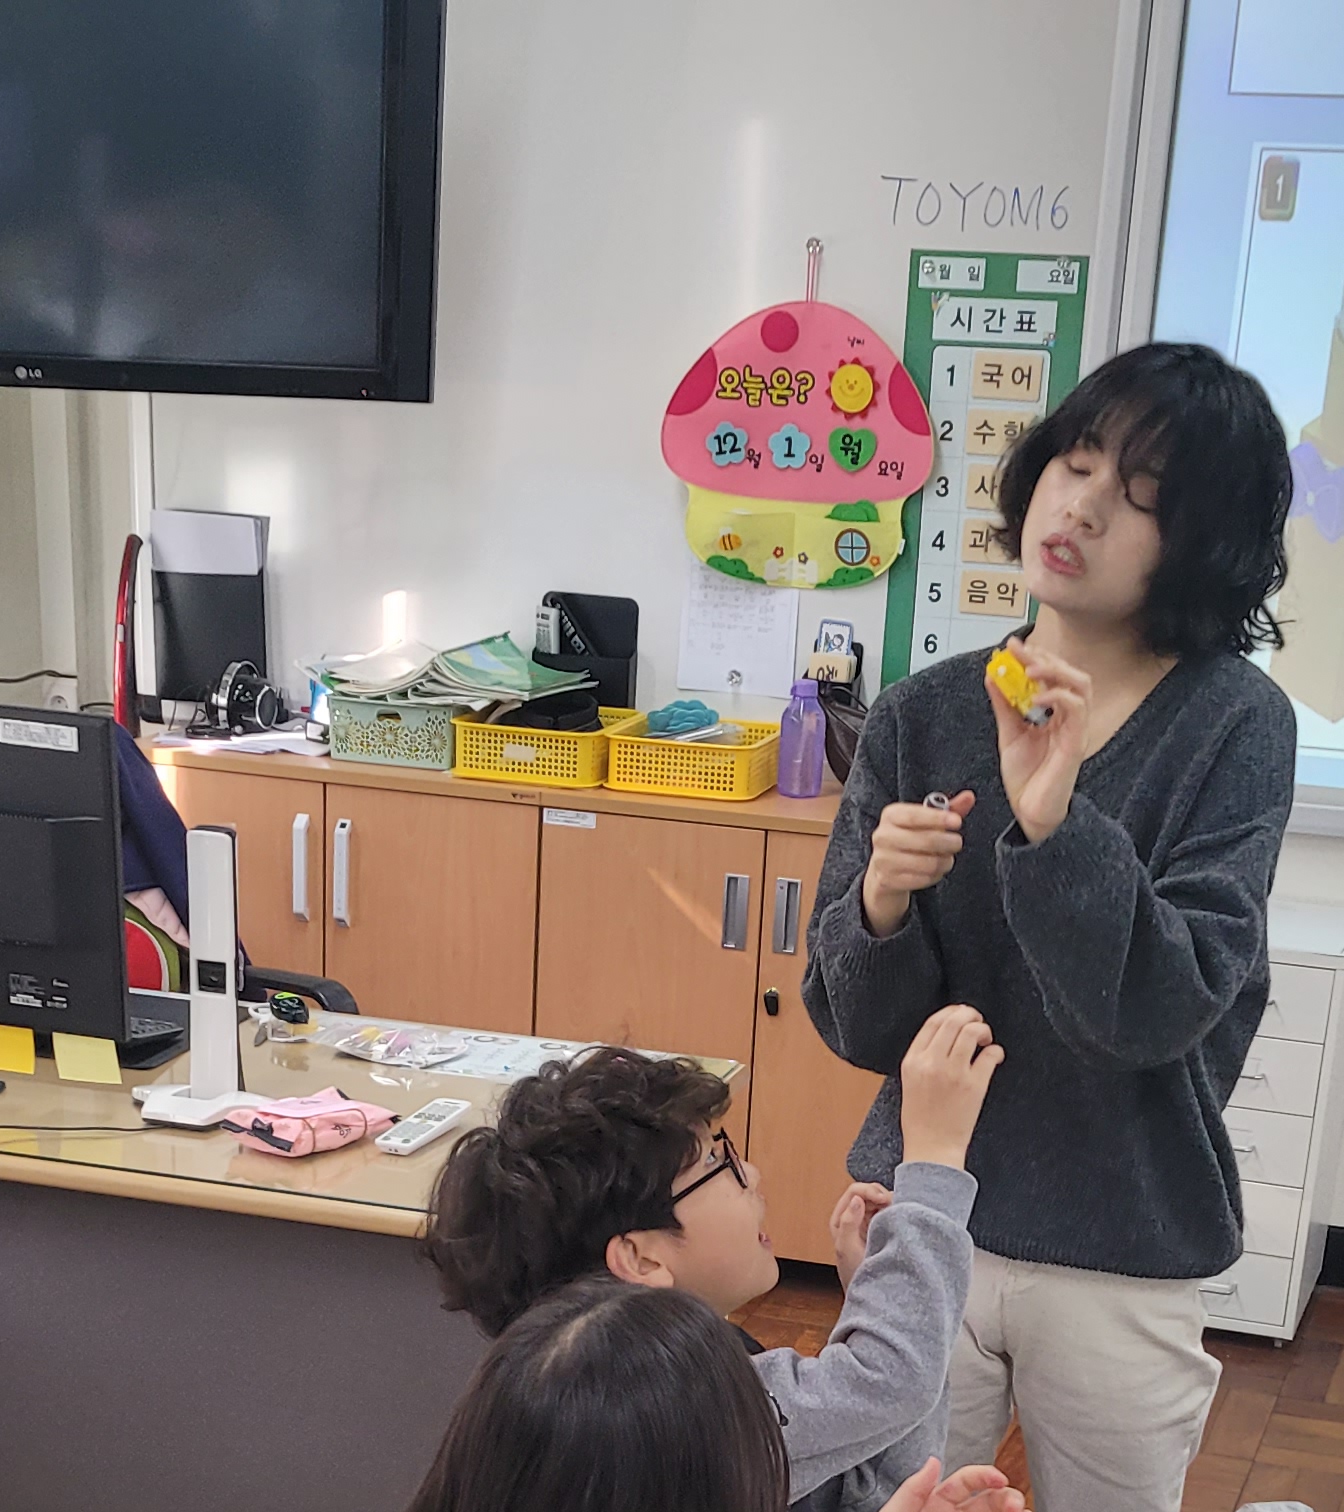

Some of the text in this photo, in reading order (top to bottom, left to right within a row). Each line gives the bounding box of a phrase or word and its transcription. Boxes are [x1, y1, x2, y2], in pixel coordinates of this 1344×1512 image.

[1275, 173, 1285, 202] 1
[939, 263, 1075, 285] 월 일 요일
[716, 365, 815, 408] 오늘은?
[946, 363, 1033, 391] 1 국어
[939, 420, 954, 441] 2
[713, 432, 905, 480] 12 월 1 일 월 요일
[935, 476, 949, 497] 3
[931, 530, 945, 551] 4
[928, 579, 1019, 607] 5 음악
[923, 634, 938, 654] 6
